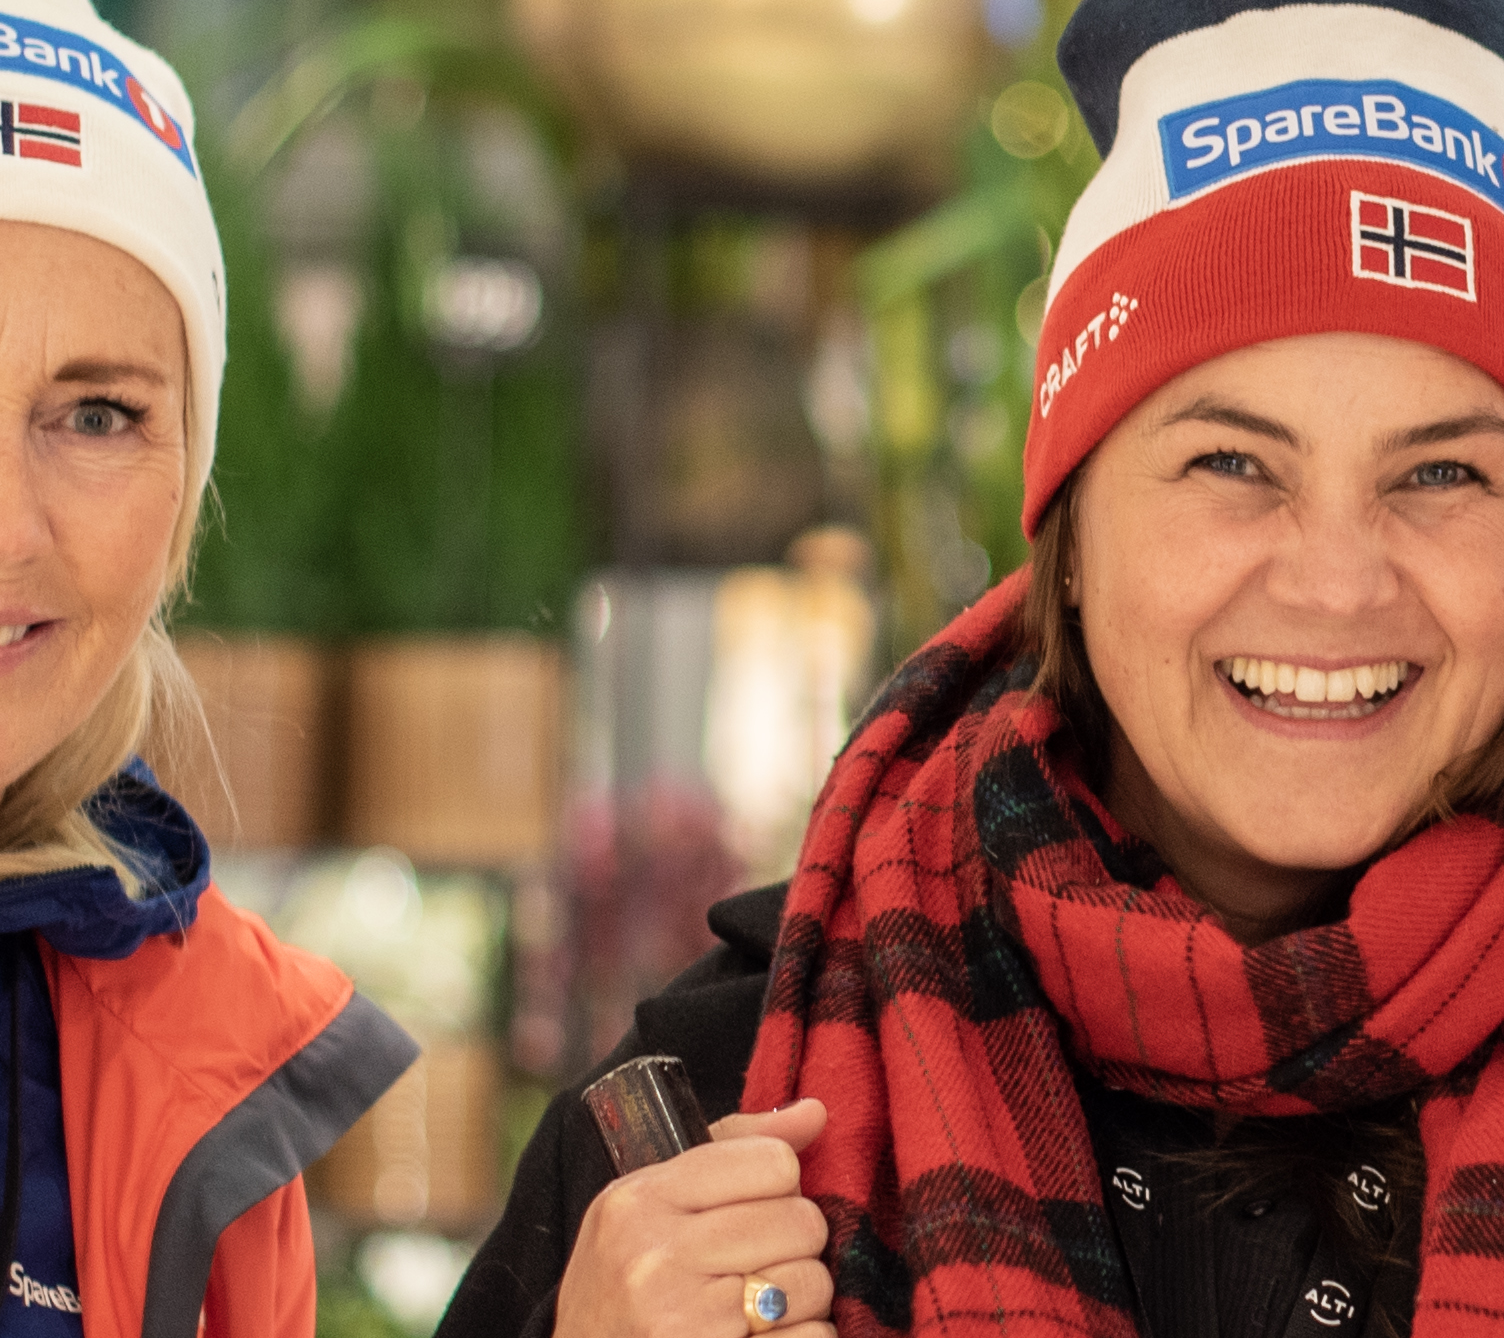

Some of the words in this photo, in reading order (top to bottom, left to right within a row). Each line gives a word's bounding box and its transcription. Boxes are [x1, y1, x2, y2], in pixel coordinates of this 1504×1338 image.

[1181, 93, 1500, 188] SpareBank
[1038, 313, 1107, 419] CRAFT
[1112, 1175, 1150, 1201] ALTI
[1347, 1171, 1391, 1204] ALTI
[1305, 1287, 1355, 1320] ALTI
